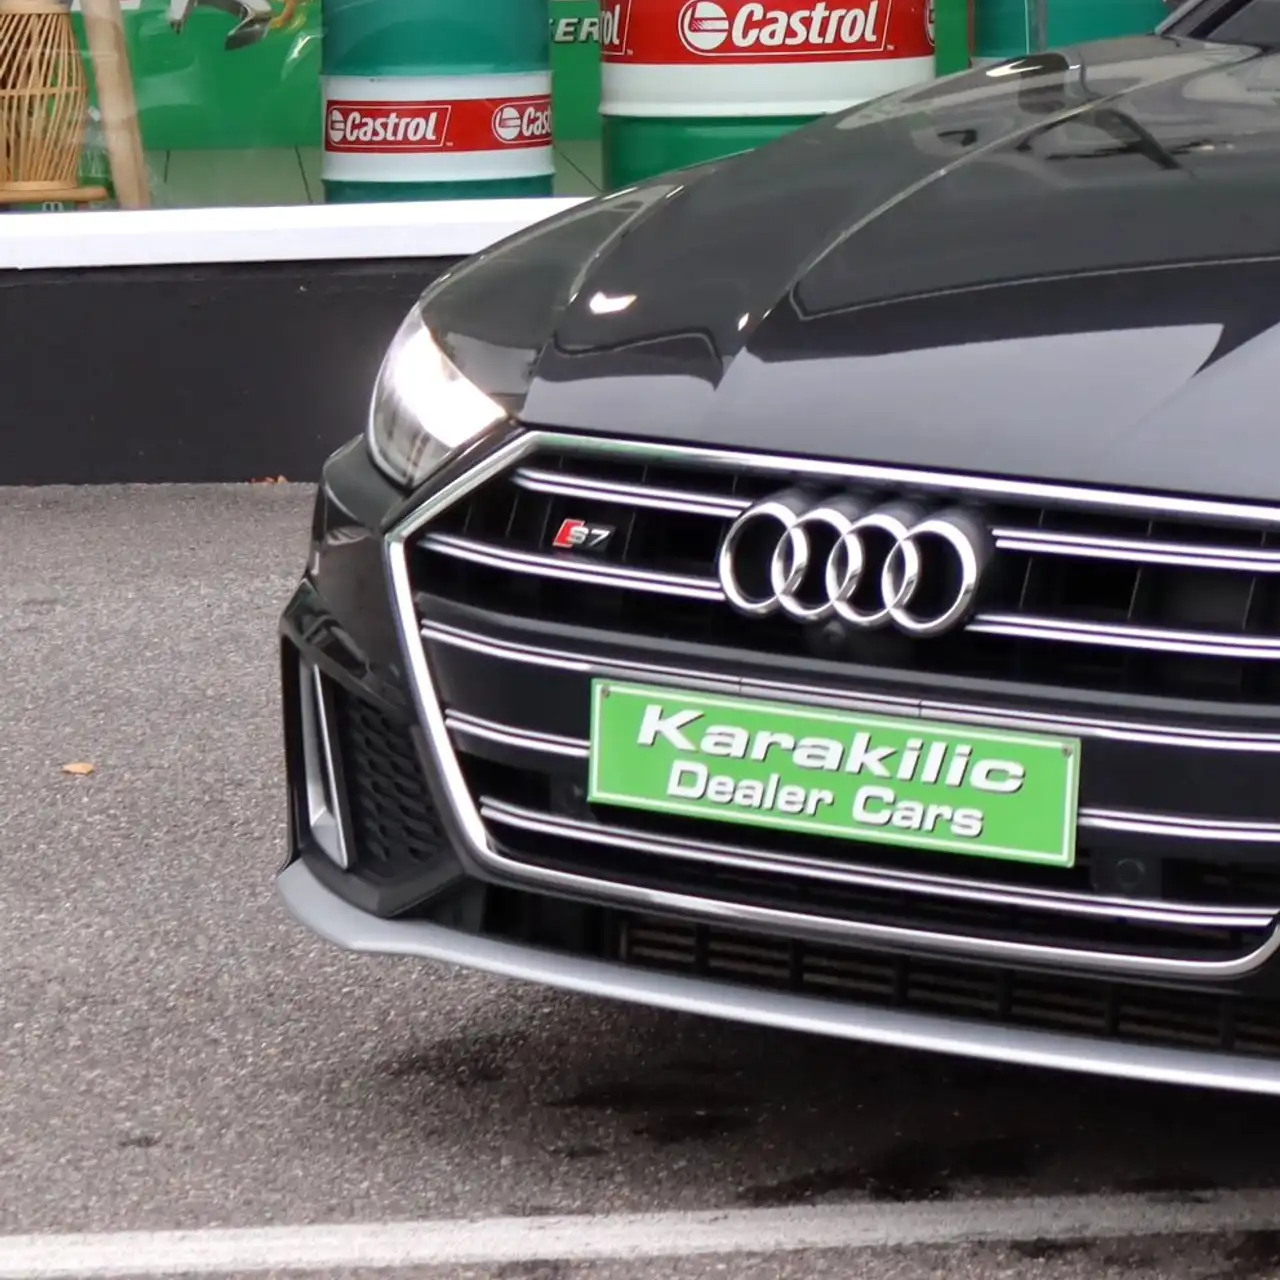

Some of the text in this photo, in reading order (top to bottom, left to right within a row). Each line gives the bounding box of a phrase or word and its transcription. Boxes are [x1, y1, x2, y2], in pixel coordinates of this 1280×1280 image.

[731, 0, 879, 48] Castrol
[345, 109, 437, 142] Castrol
[560, 520, 611, 548] S7
[635, 703, 1026, 794] Karakilic
[666, 758, 985, 839] Dealer Cars
